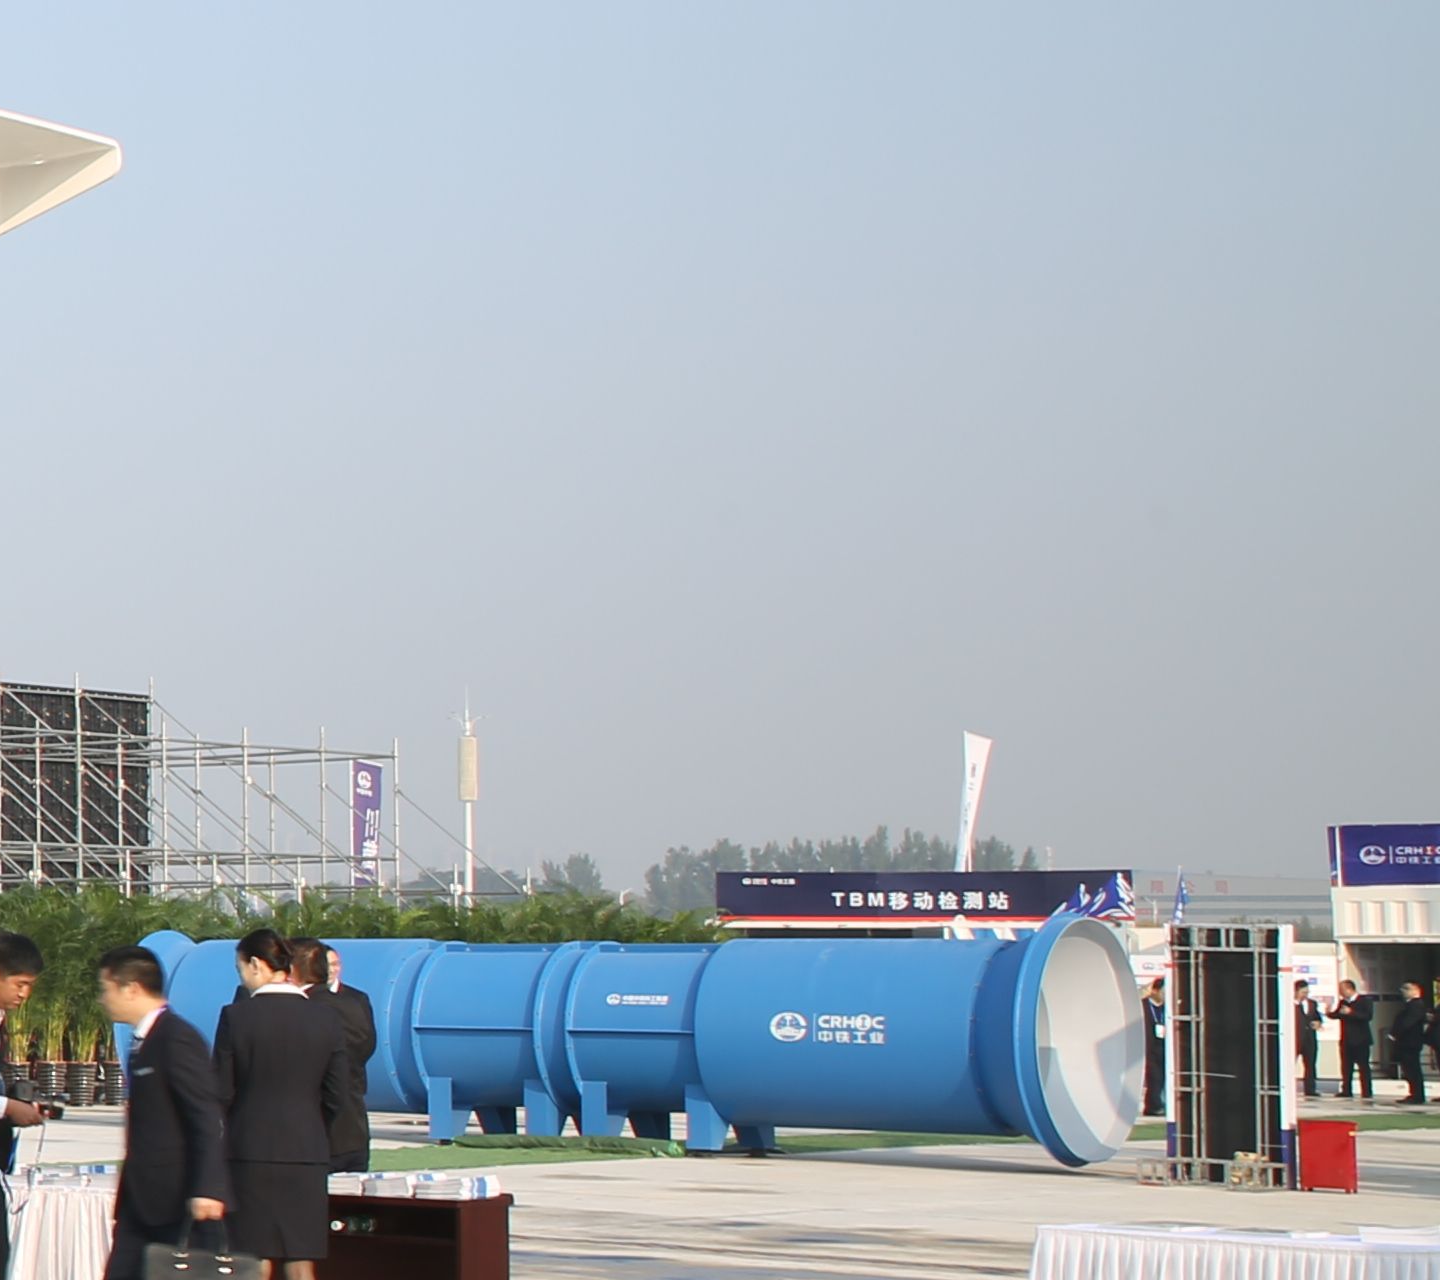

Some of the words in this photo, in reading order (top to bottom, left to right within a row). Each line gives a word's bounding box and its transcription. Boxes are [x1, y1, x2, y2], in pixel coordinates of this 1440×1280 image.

[831, 891, 1010, 911] TBM移动检测站
[817, 1031, 886, 1045] 中铁工业
